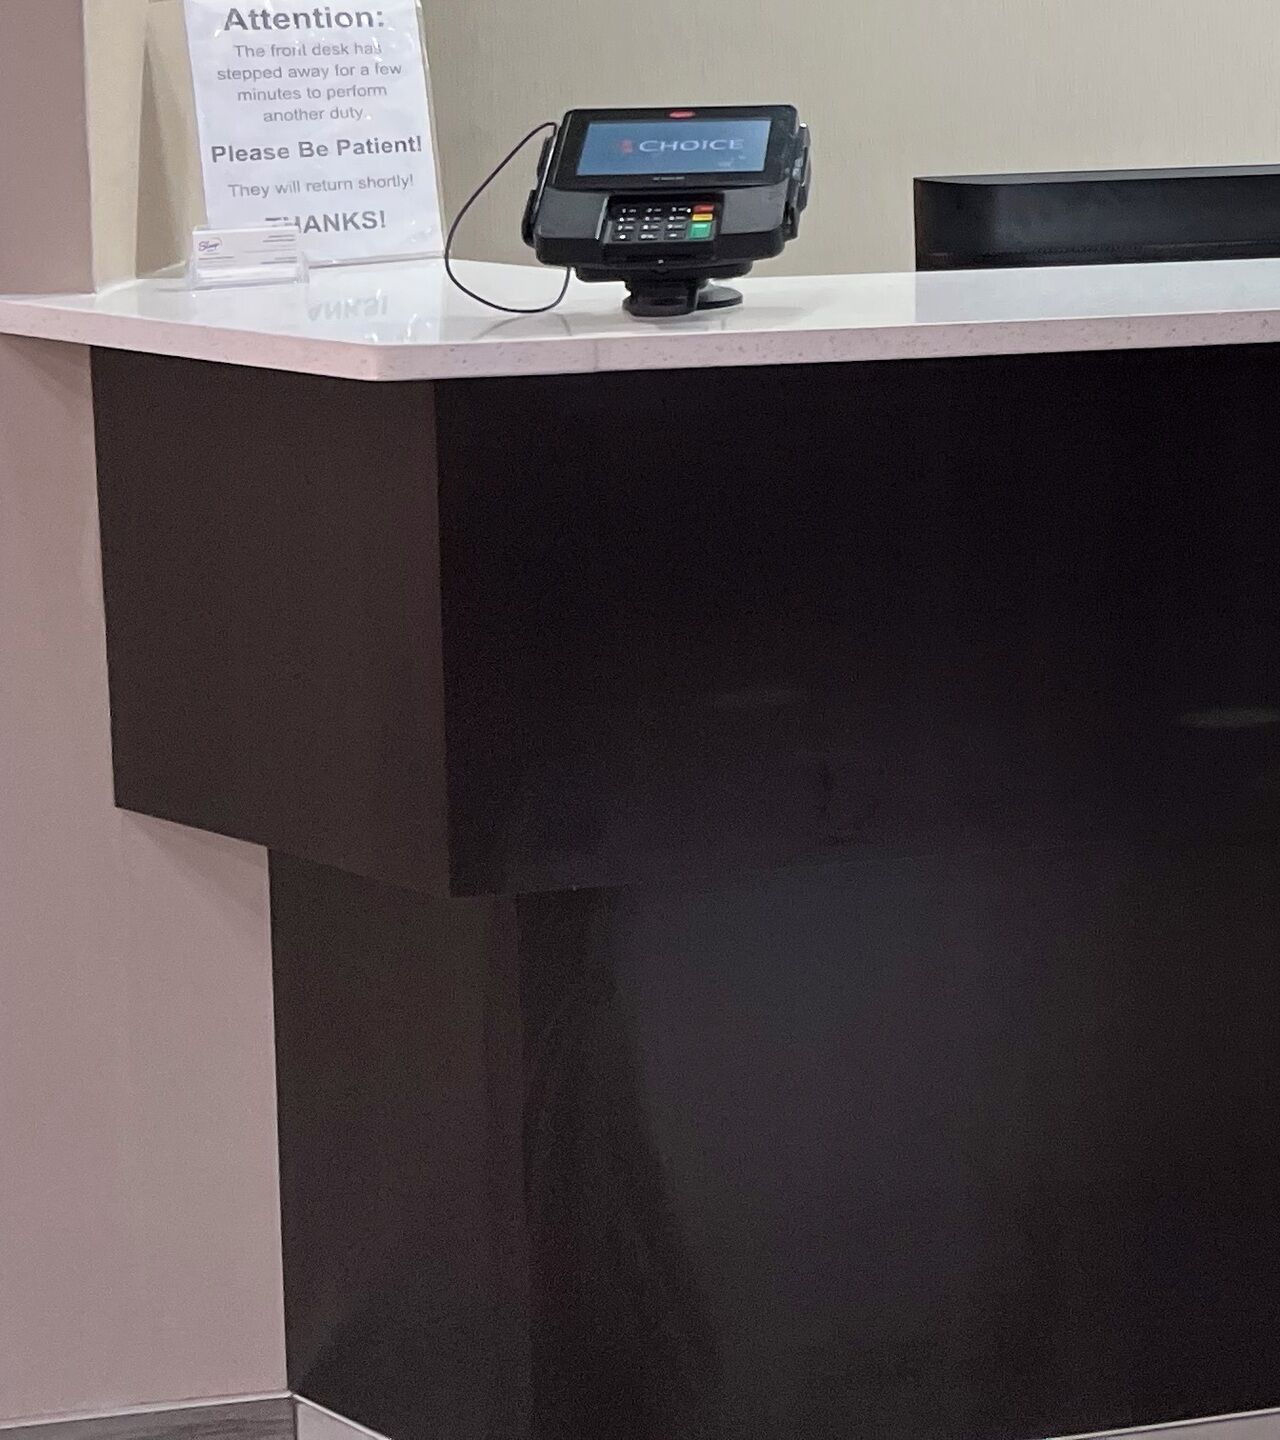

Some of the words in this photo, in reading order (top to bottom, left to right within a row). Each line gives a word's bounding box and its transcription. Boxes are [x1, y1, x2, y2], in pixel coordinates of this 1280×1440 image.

[224, 6, 384, 31] Attention:
[234, 44, 265, 58] The
[271, 43, 307, 57] front
[312, 42, 349, 56] desk
[354, 42, 383, 55] has
[217, 66, 283, 82] stepped
[288, 67, 329, 80] away
[335, 64, 355, 76] for
[360, 66, 369, 76] a
[375, 63, 402, 75] few
[237, 88, 301, 101] minutes
[307, 88, 321, 99] to
[327, 85, 387, 101] perform
[263, 108, 324, 122] another
[211, 145, 290, 163] Please
[298, 141, 328, 158] Be
[336, 135, 422, 156] Patient!
[639, 140, 744, 152] CHOICE
[228, 183, 269, 199] They
[275, 180, 300, 194] will
[306, 178, 353, 192] return
[358, 174, 414, 191] shortly!
